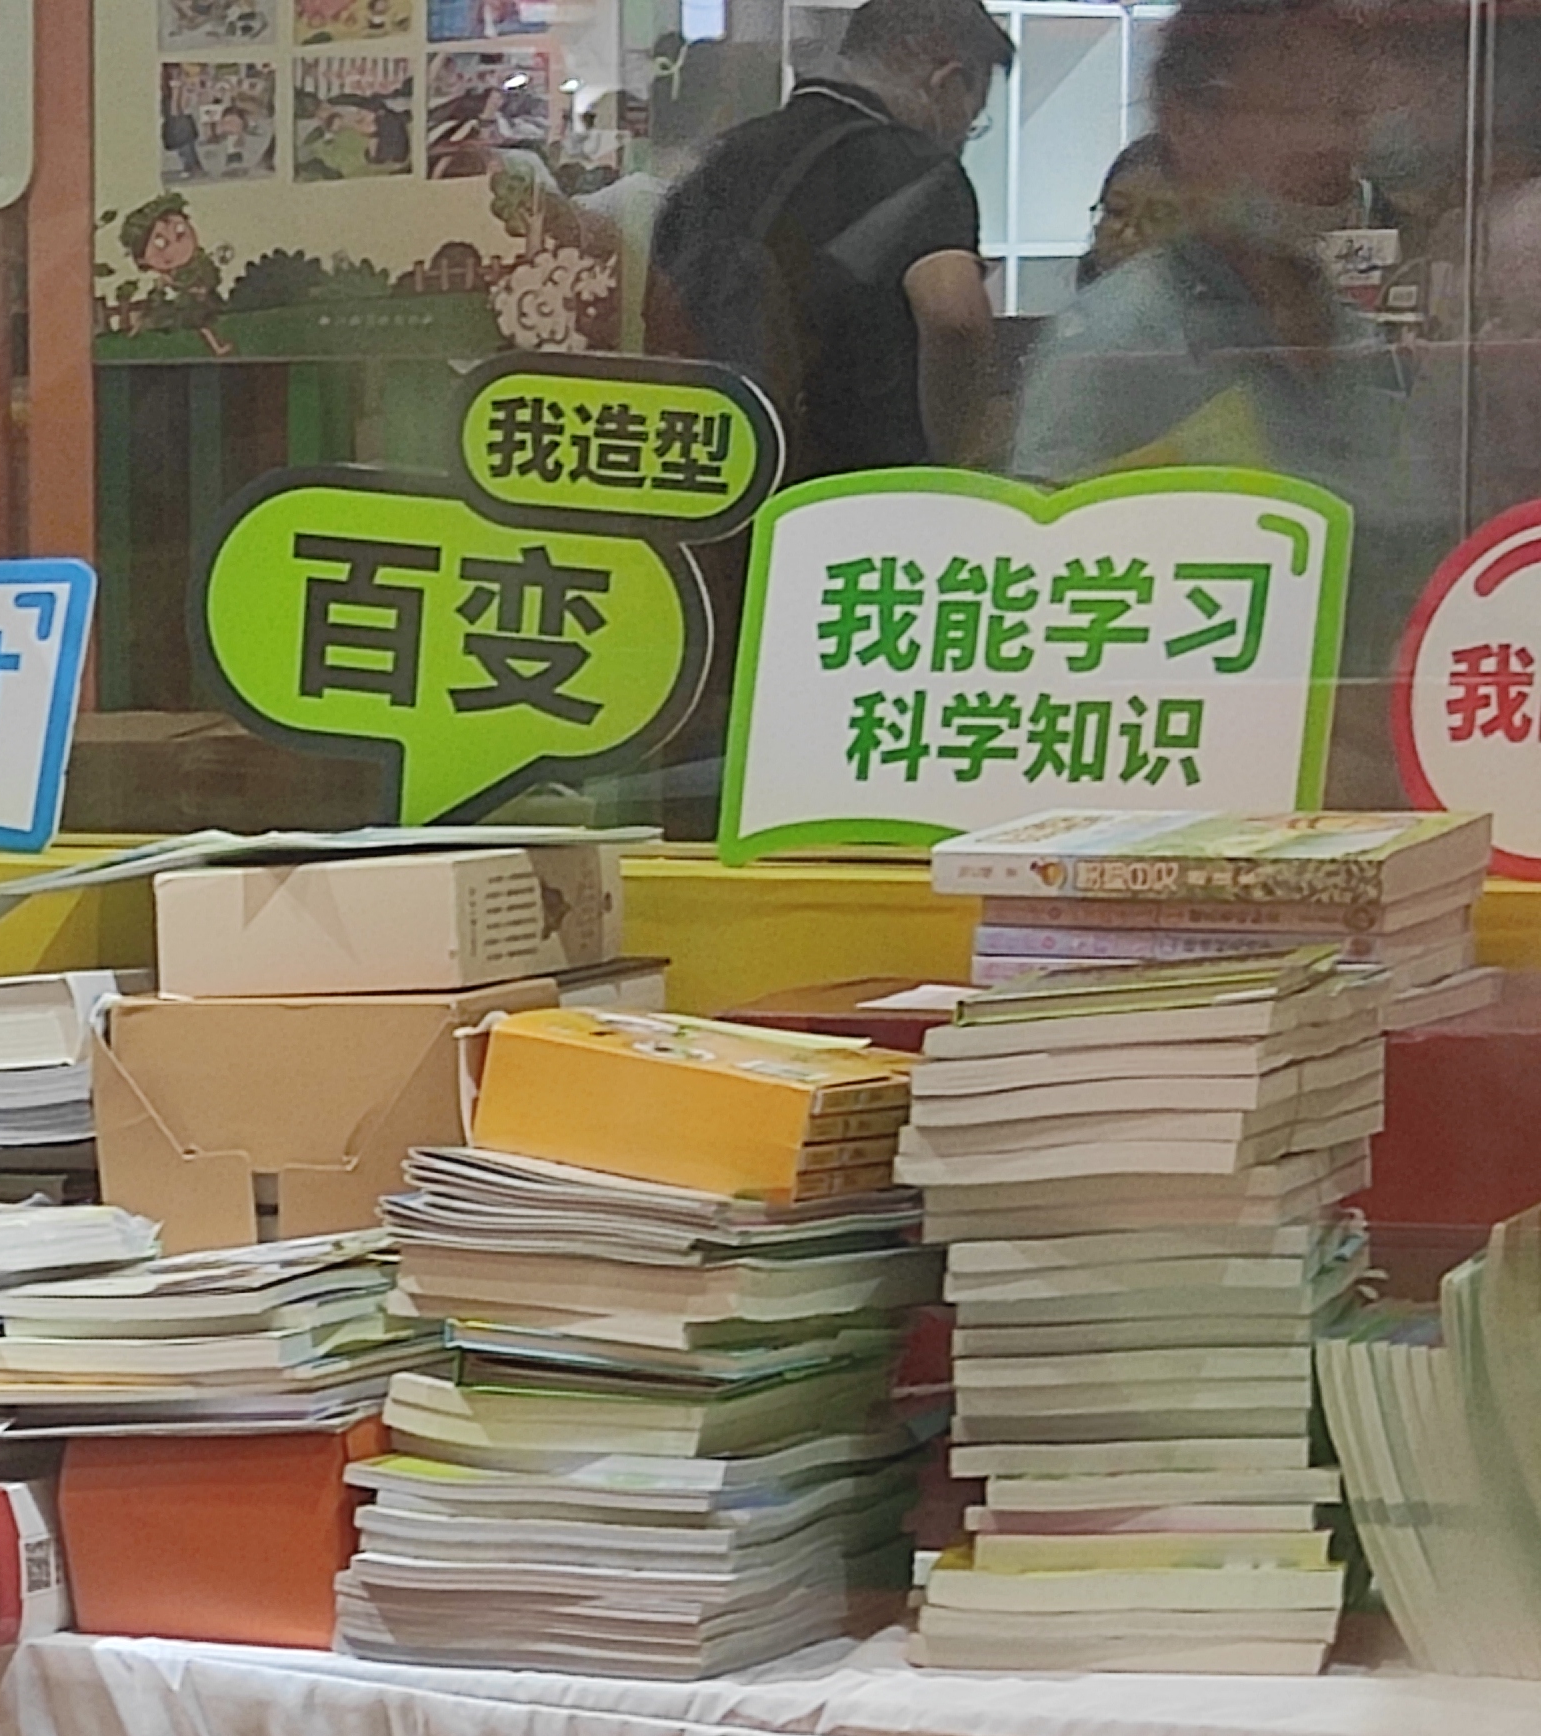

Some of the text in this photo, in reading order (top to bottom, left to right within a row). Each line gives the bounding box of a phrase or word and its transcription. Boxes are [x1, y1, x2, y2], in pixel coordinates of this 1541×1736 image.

[486, 395, 732, 496] 我造型
[292, 531, 613, 725] 百变
[816, 555, 1274, 674] 我能学习
[845, 689, 1206, 786] 科学知识
[1445, 643, 1541, 743] 我
